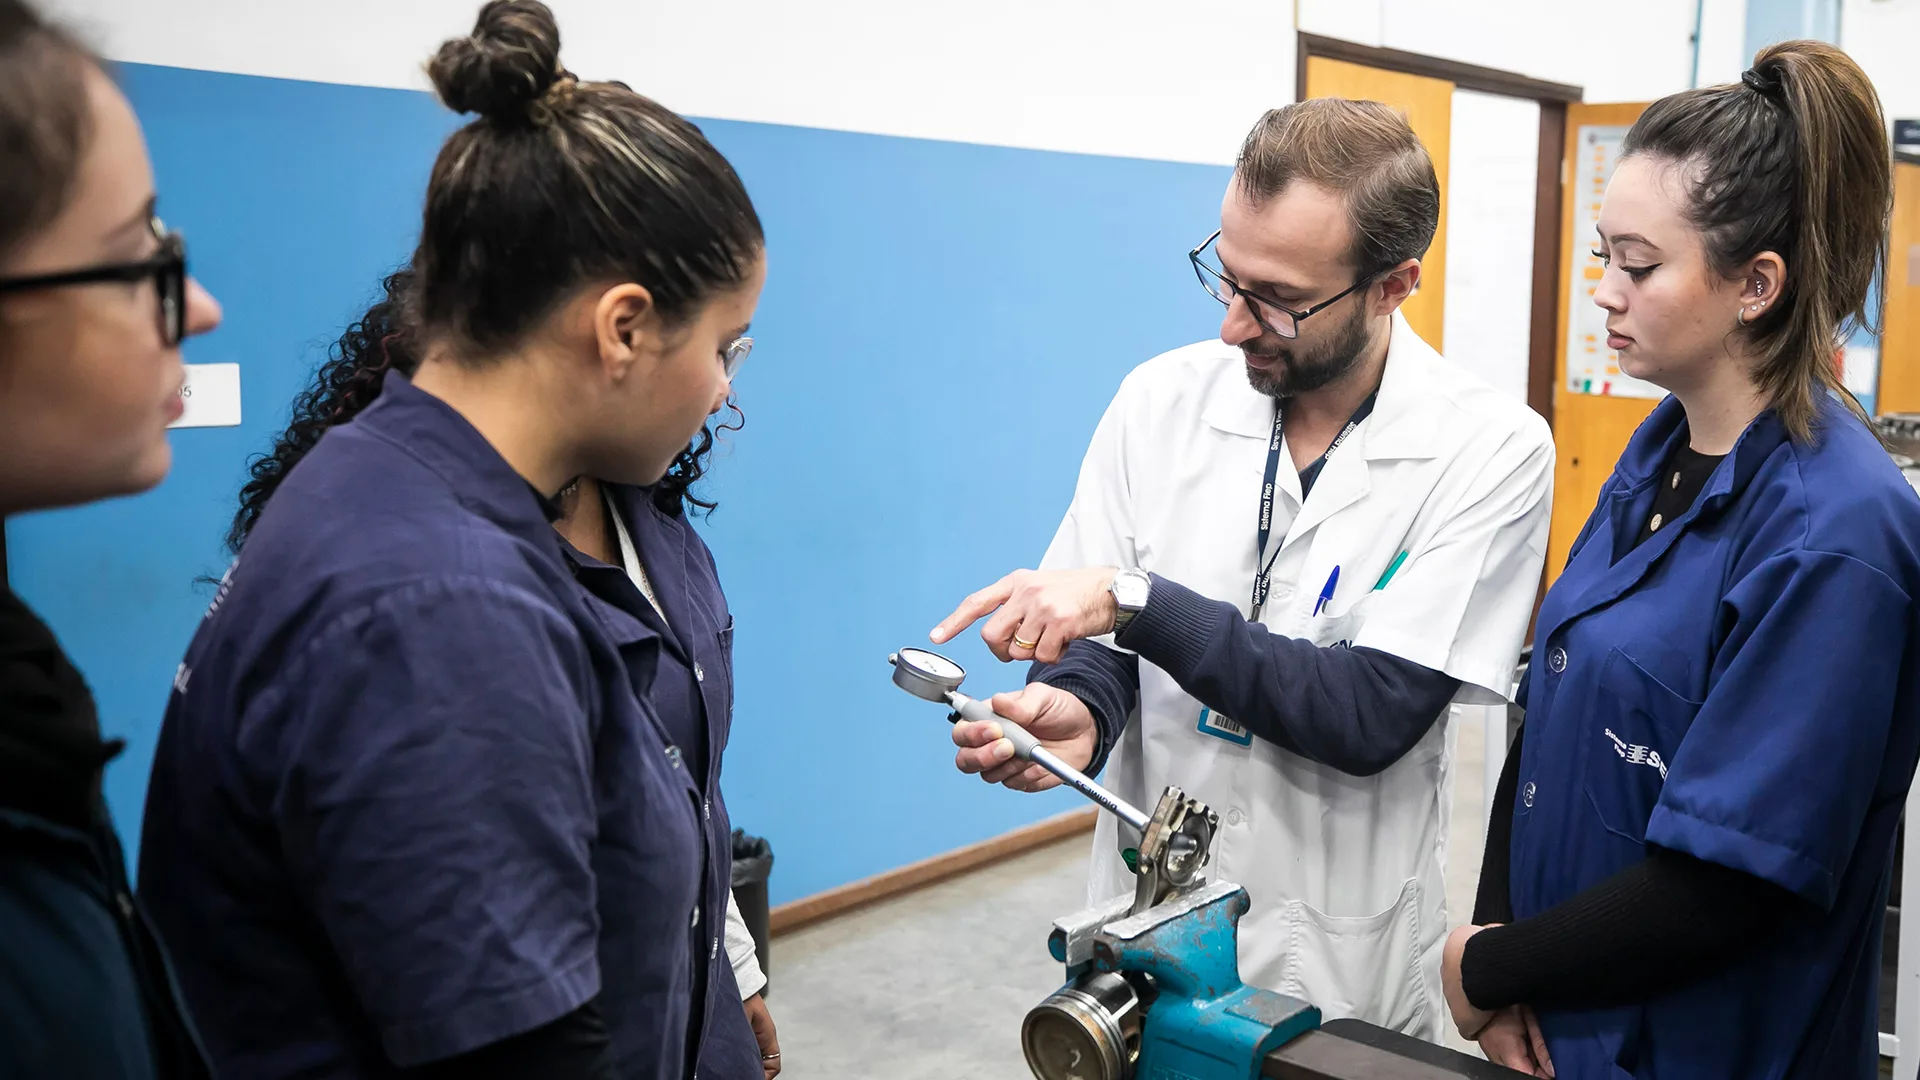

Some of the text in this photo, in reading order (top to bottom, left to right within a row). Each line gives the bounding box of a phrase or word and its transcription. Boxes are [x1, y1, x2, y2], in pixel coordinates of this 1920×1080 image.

[1324, 421, 1357, 461] Sistema Fiep
[1261, 483, 1273, 531] Sistema Fiep
[1605, 728, 1626, 749] Sistema
